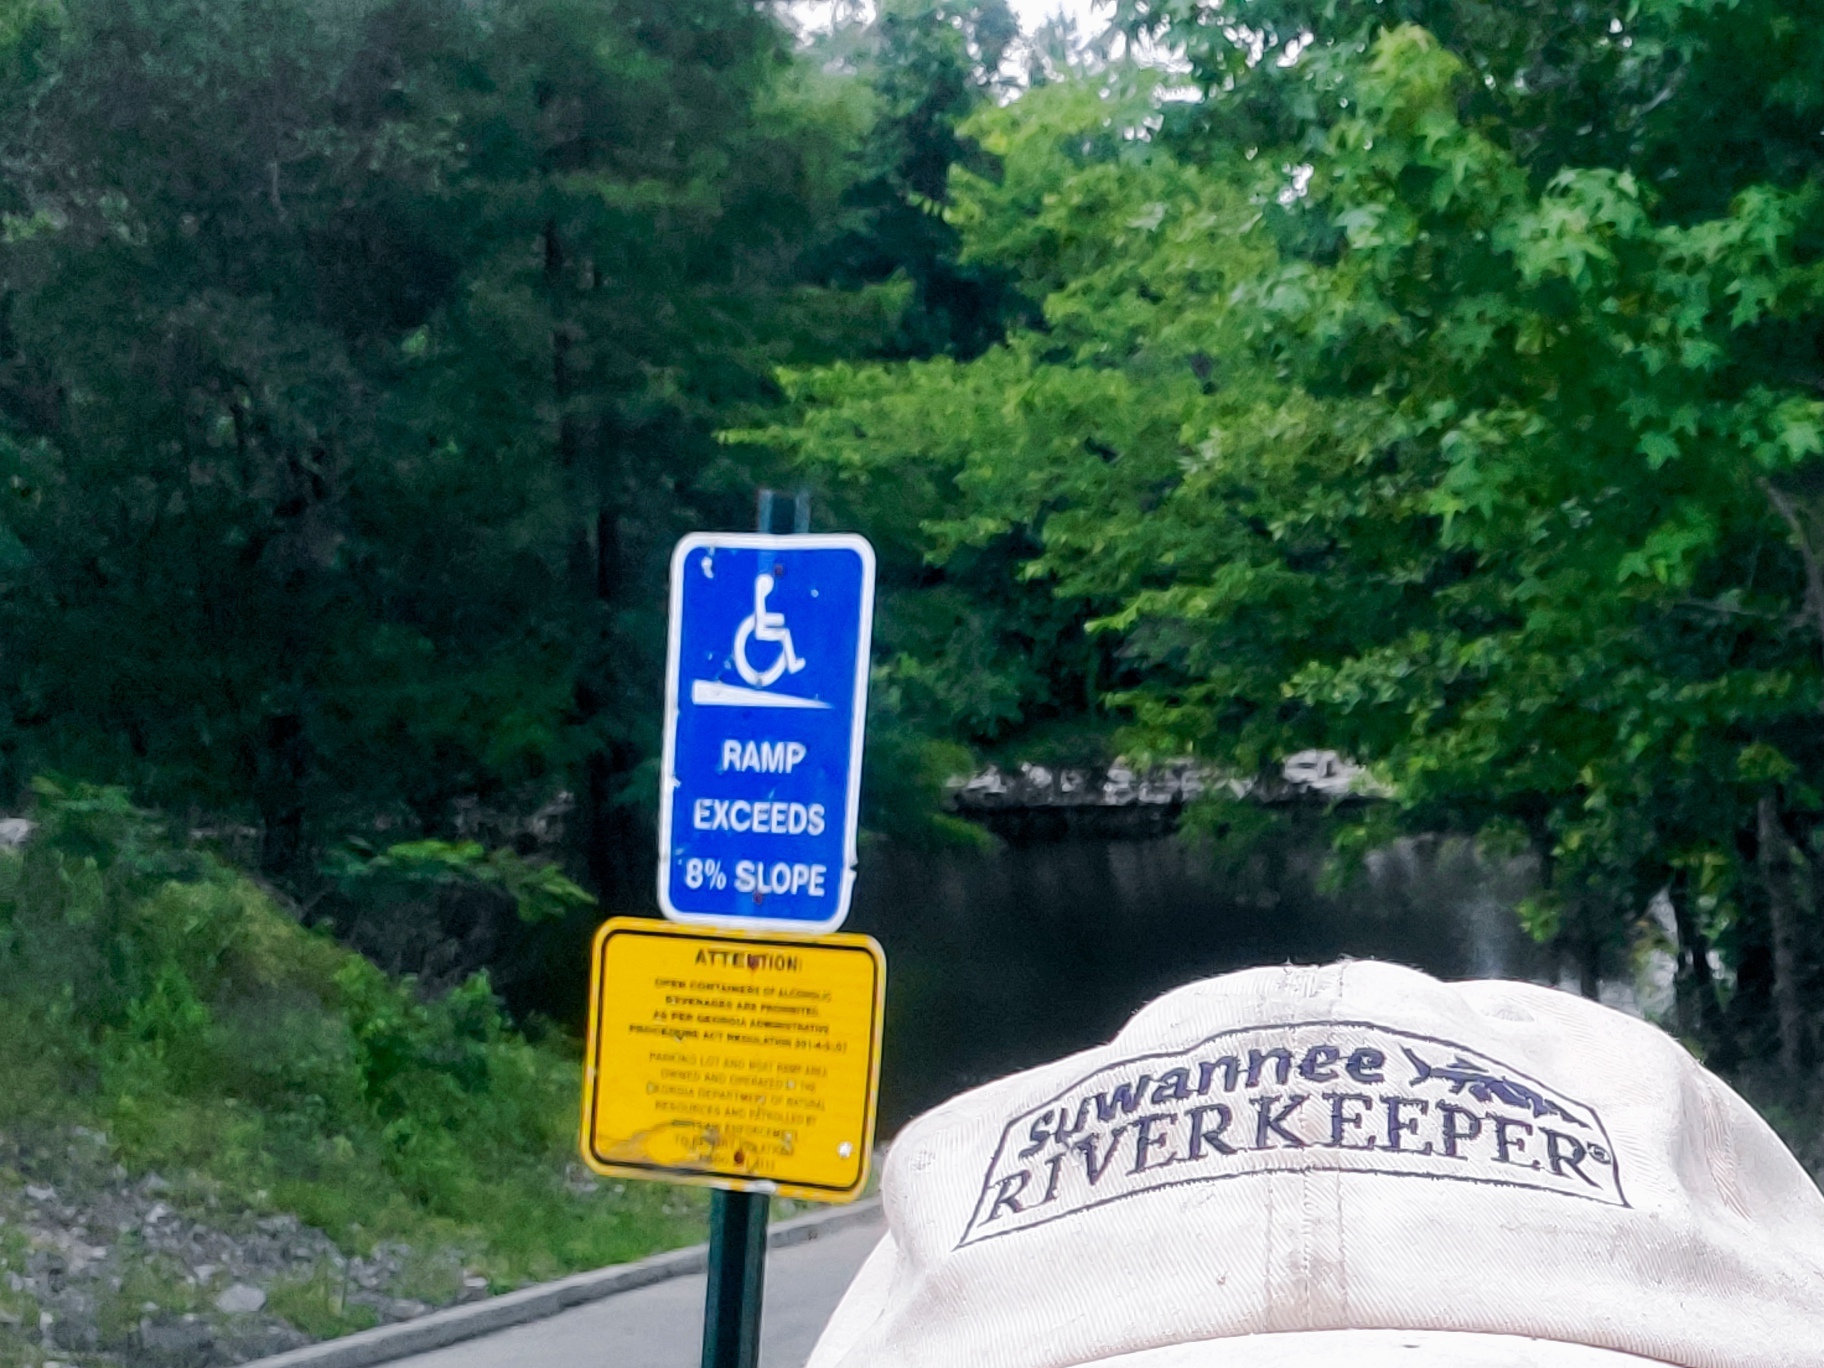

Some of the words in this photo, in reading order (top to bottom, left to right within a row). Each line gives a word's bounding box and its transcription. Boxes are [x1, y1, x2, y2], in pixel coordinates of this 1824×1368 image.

[722, 739, 807, 774] RAMP
[693, 798, 825, 836] EXCEEDS
[685, 857, 727, 890] 8%
[734, 860, 827, 897] SLOPE
